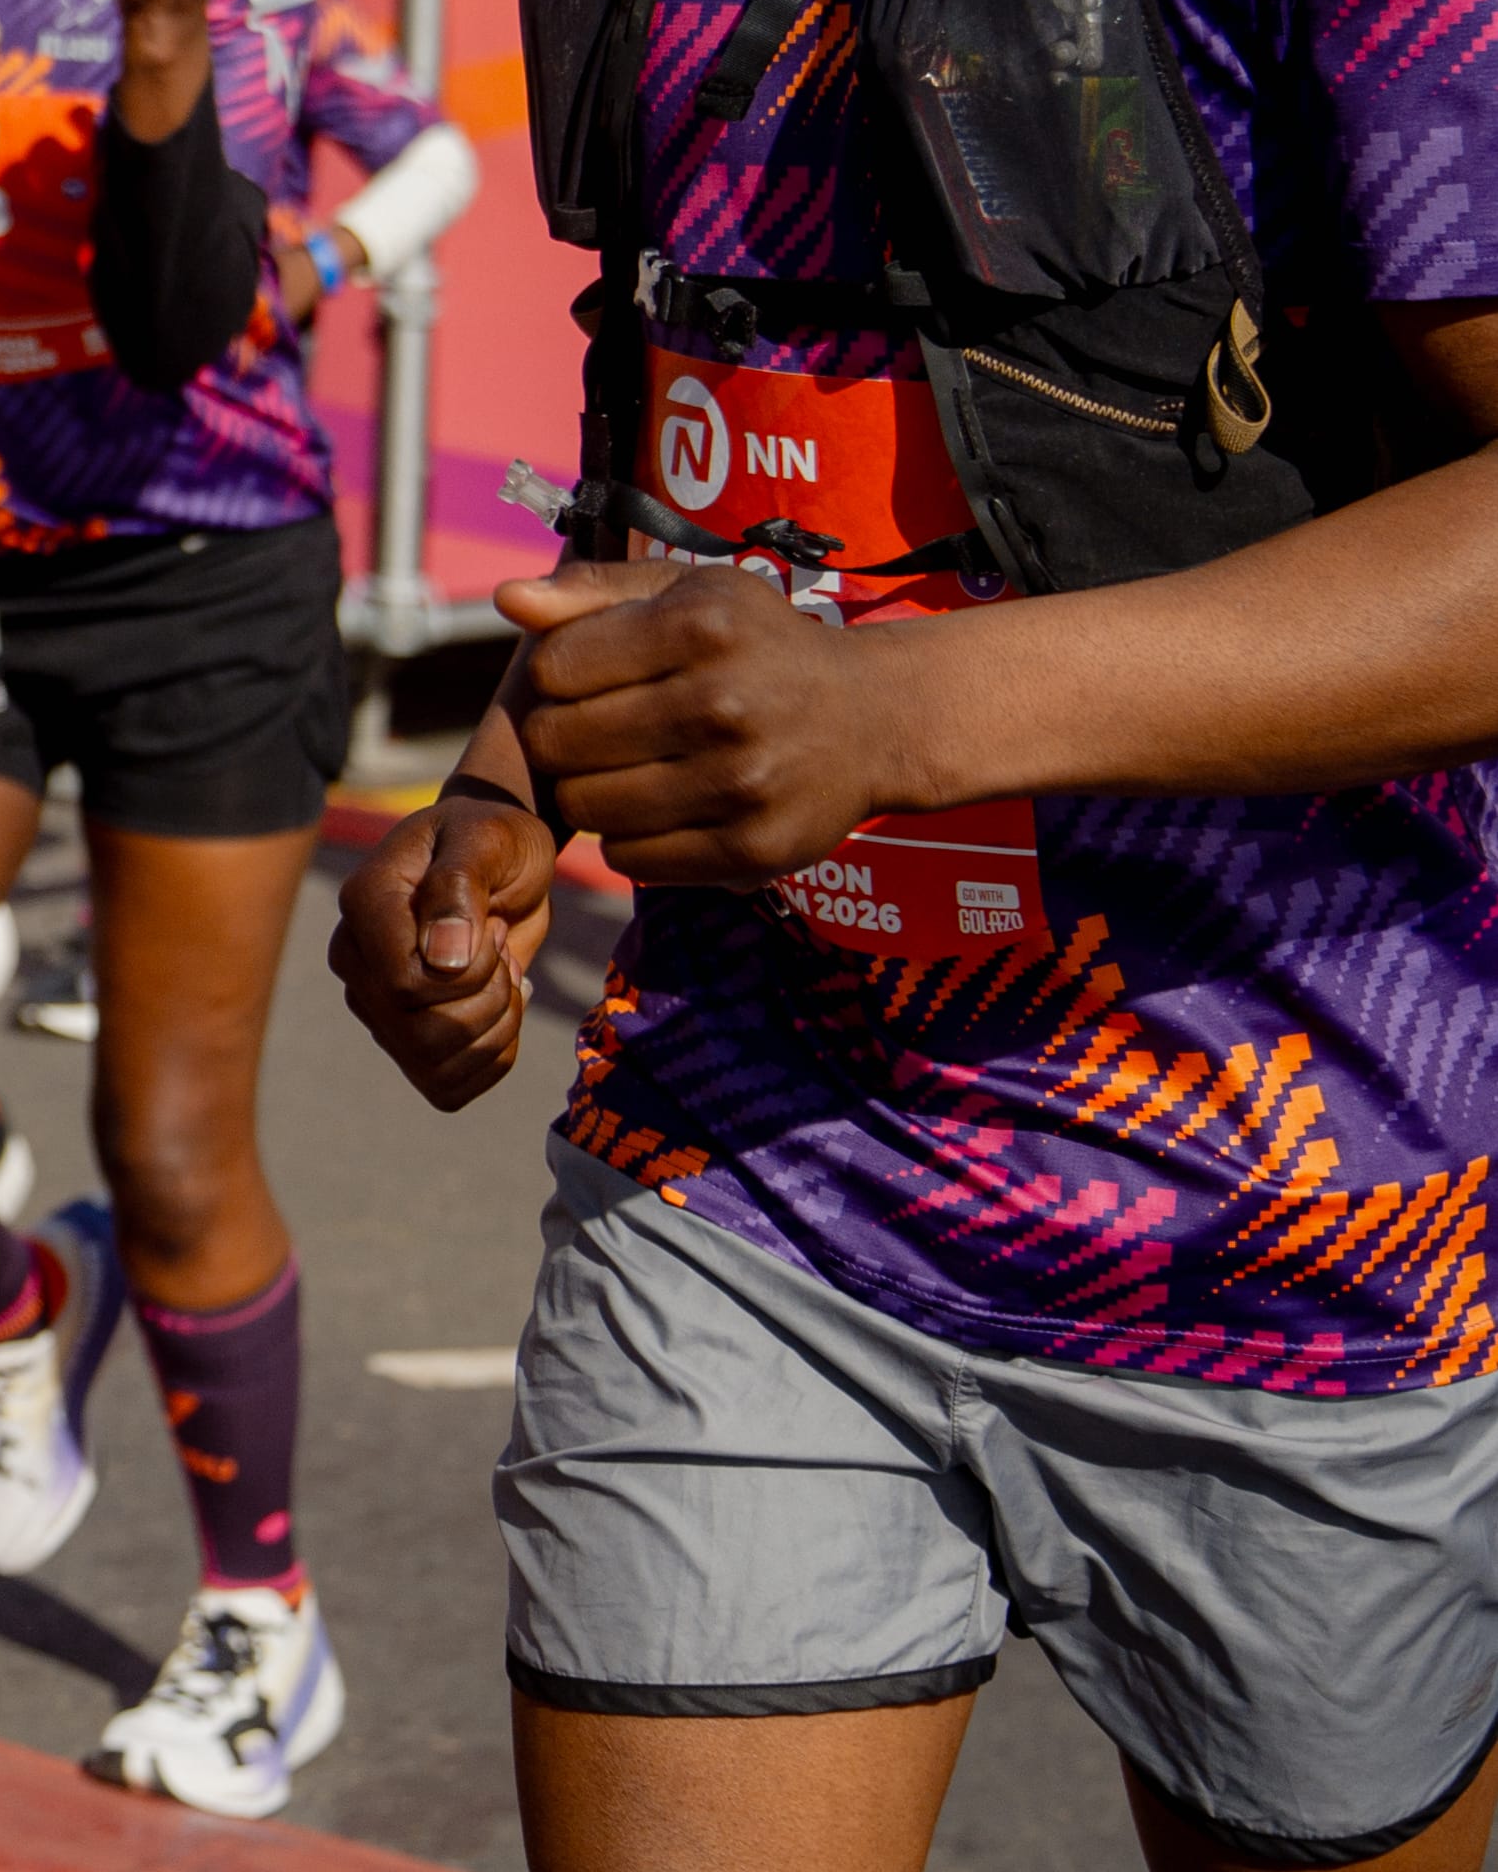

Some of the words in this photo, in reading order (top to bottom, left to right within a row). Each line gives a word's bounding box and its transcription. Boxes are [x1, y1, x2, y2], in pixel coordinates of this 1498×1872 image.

[745, 432, 818, 483] NN
[813, 892, 903, 934] 2026
[978, 891, 1004, 903] WITH
[958, 908, 1025, 935] GOLAZO
